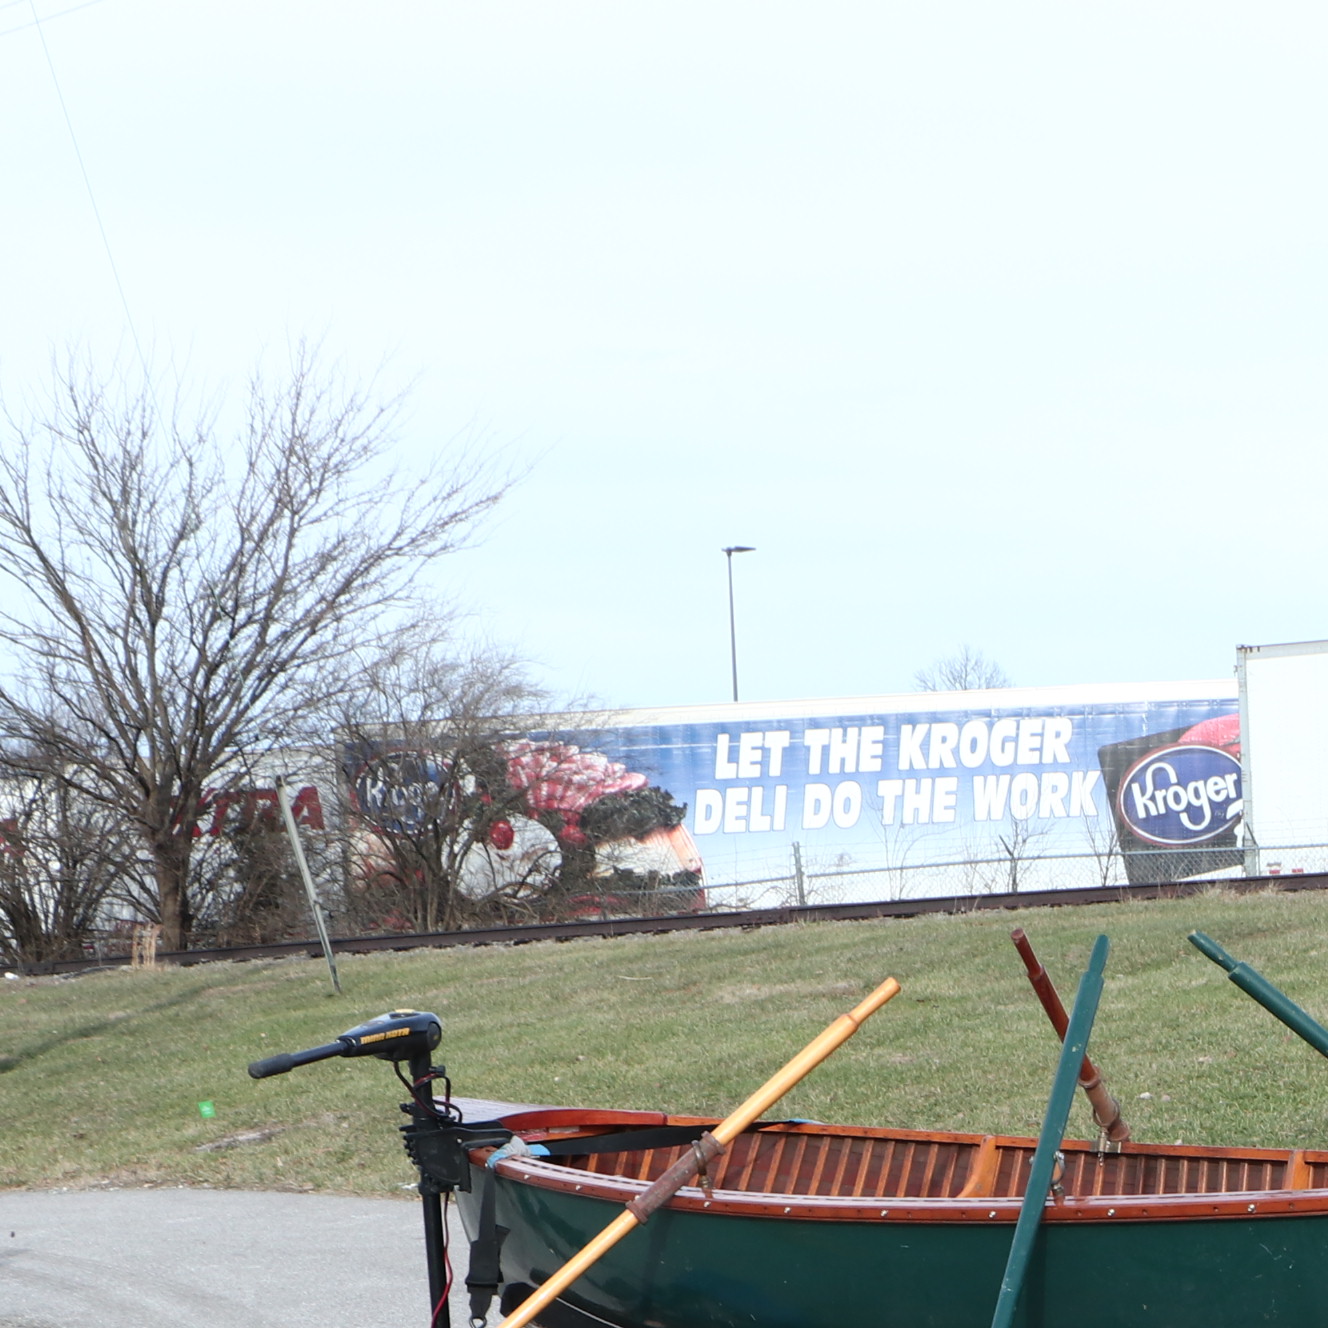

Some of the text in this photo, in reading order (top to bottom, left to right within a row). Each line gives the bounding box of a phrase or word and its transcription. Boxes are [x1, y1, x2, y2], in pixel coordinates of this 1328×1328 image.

[715, 718, 1072, 779] LET THE KROGER
[694, 771, 1100, 835] DELI DO THE WORK
[1131, 762, 1238, 831] Kroger
